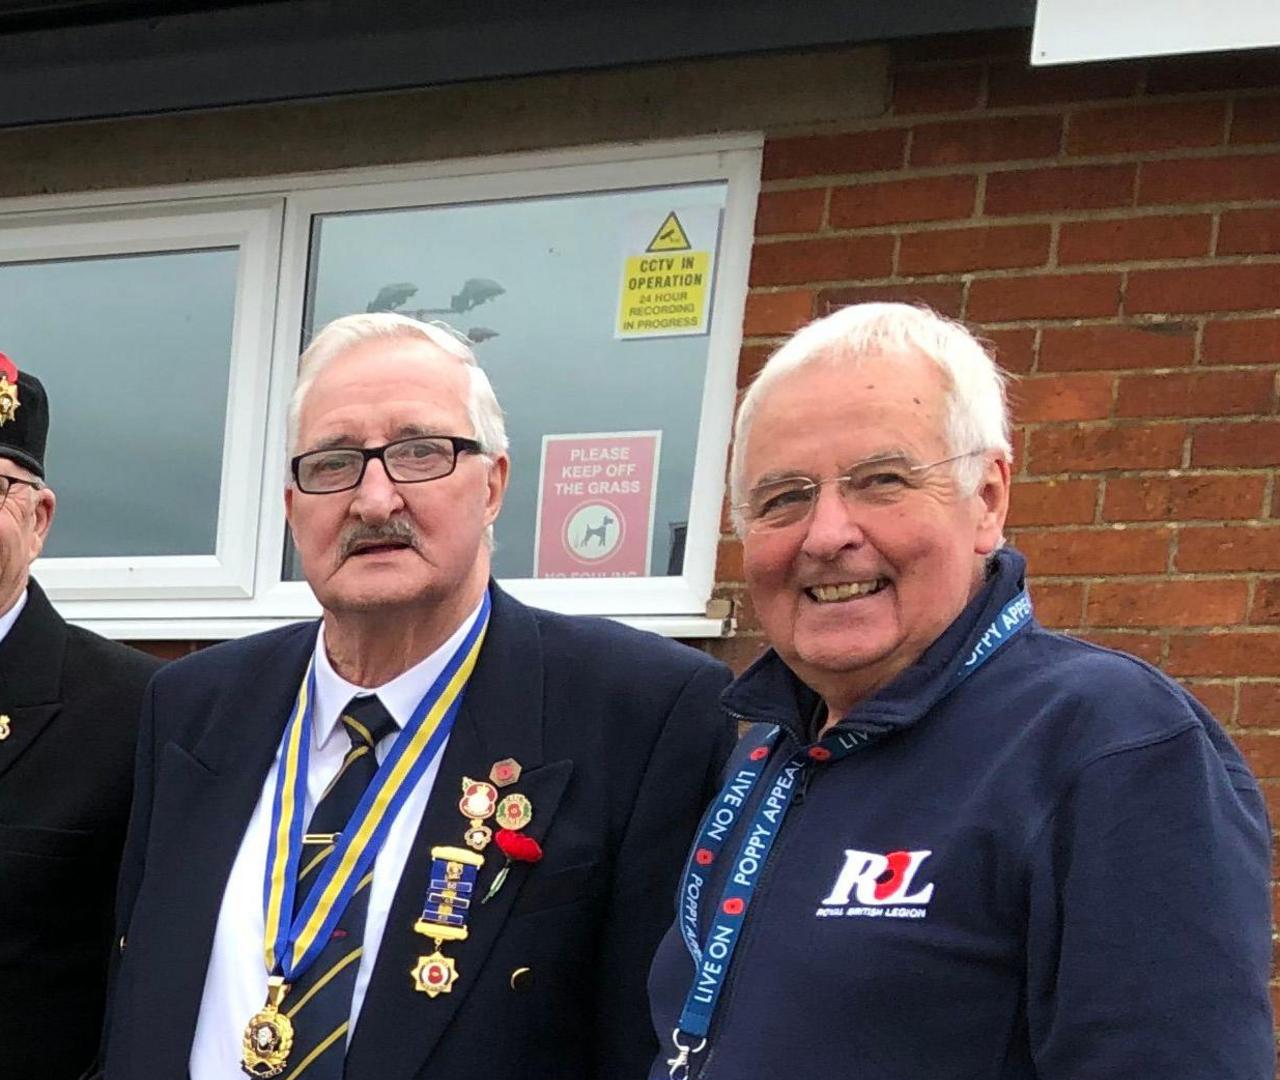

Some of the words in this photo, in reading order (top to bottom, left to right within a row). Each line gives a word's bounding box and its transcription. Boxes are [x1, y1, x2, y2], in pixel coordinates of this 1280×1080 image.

[640, 258, 674, 272] CCTV
[681, 257, 694, 269] IN
[628, 274, 702, 290] OPERATION
[639, 293, 651, 303] 24
[654, 291, 687, 302] HOUR
[629, 303, 694, 316] RECORDING
[623, 321, 634, 330] IN
[637, 316, 698, 329] PROGRESS
[570, 447, 630, 462] PLEASE
[562, 465, 602, 479] KEEP
[606, 463, 636, 477] OFF
[554, 482, 584, 496] THE
[588, 480, 641, 495] GRASS
[723, 770, 756, 808] LIVE
[707, 808, 734, 841] ON
[733, 823, 771, 886] POPPY
[763, 760, 806, 824] APPEAL
[685, 873, 704, 928] POPPY
[816, 907, 844, 917] ROYAL
[845, 907, 884, 917] BRITISH
[884, 907, 926, 918] LEGION
[694, 961, 722, 1004] LIVE
[709, 925, 735, 960] ON
